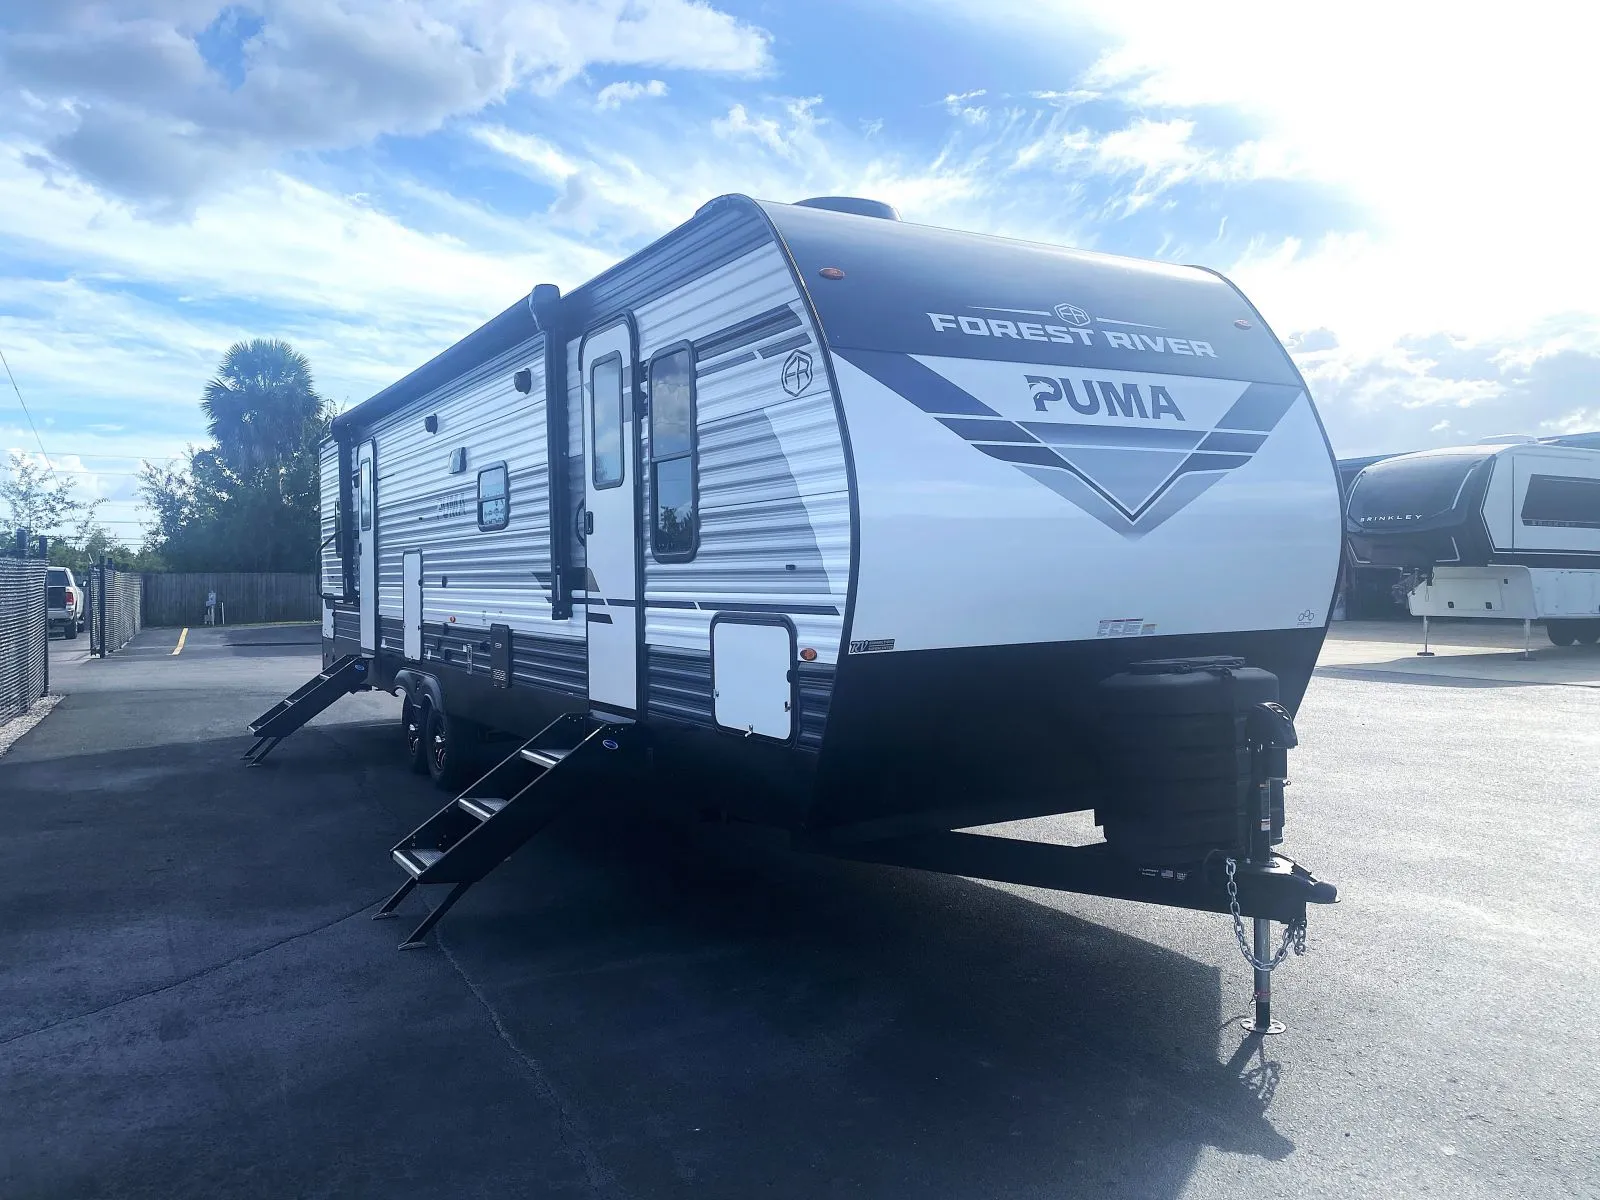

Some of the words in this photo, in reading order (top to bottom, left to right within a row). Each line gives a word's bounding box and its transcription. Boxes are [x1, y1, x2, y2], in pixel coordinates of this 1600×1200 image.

[926, 312, 1095, 347] FOREST
[1103, 331, 1219, 358] RIVER
[1024, 374, 1186, 422] PUMA
[1360, 514, 1422, 522] BRINKLEY
